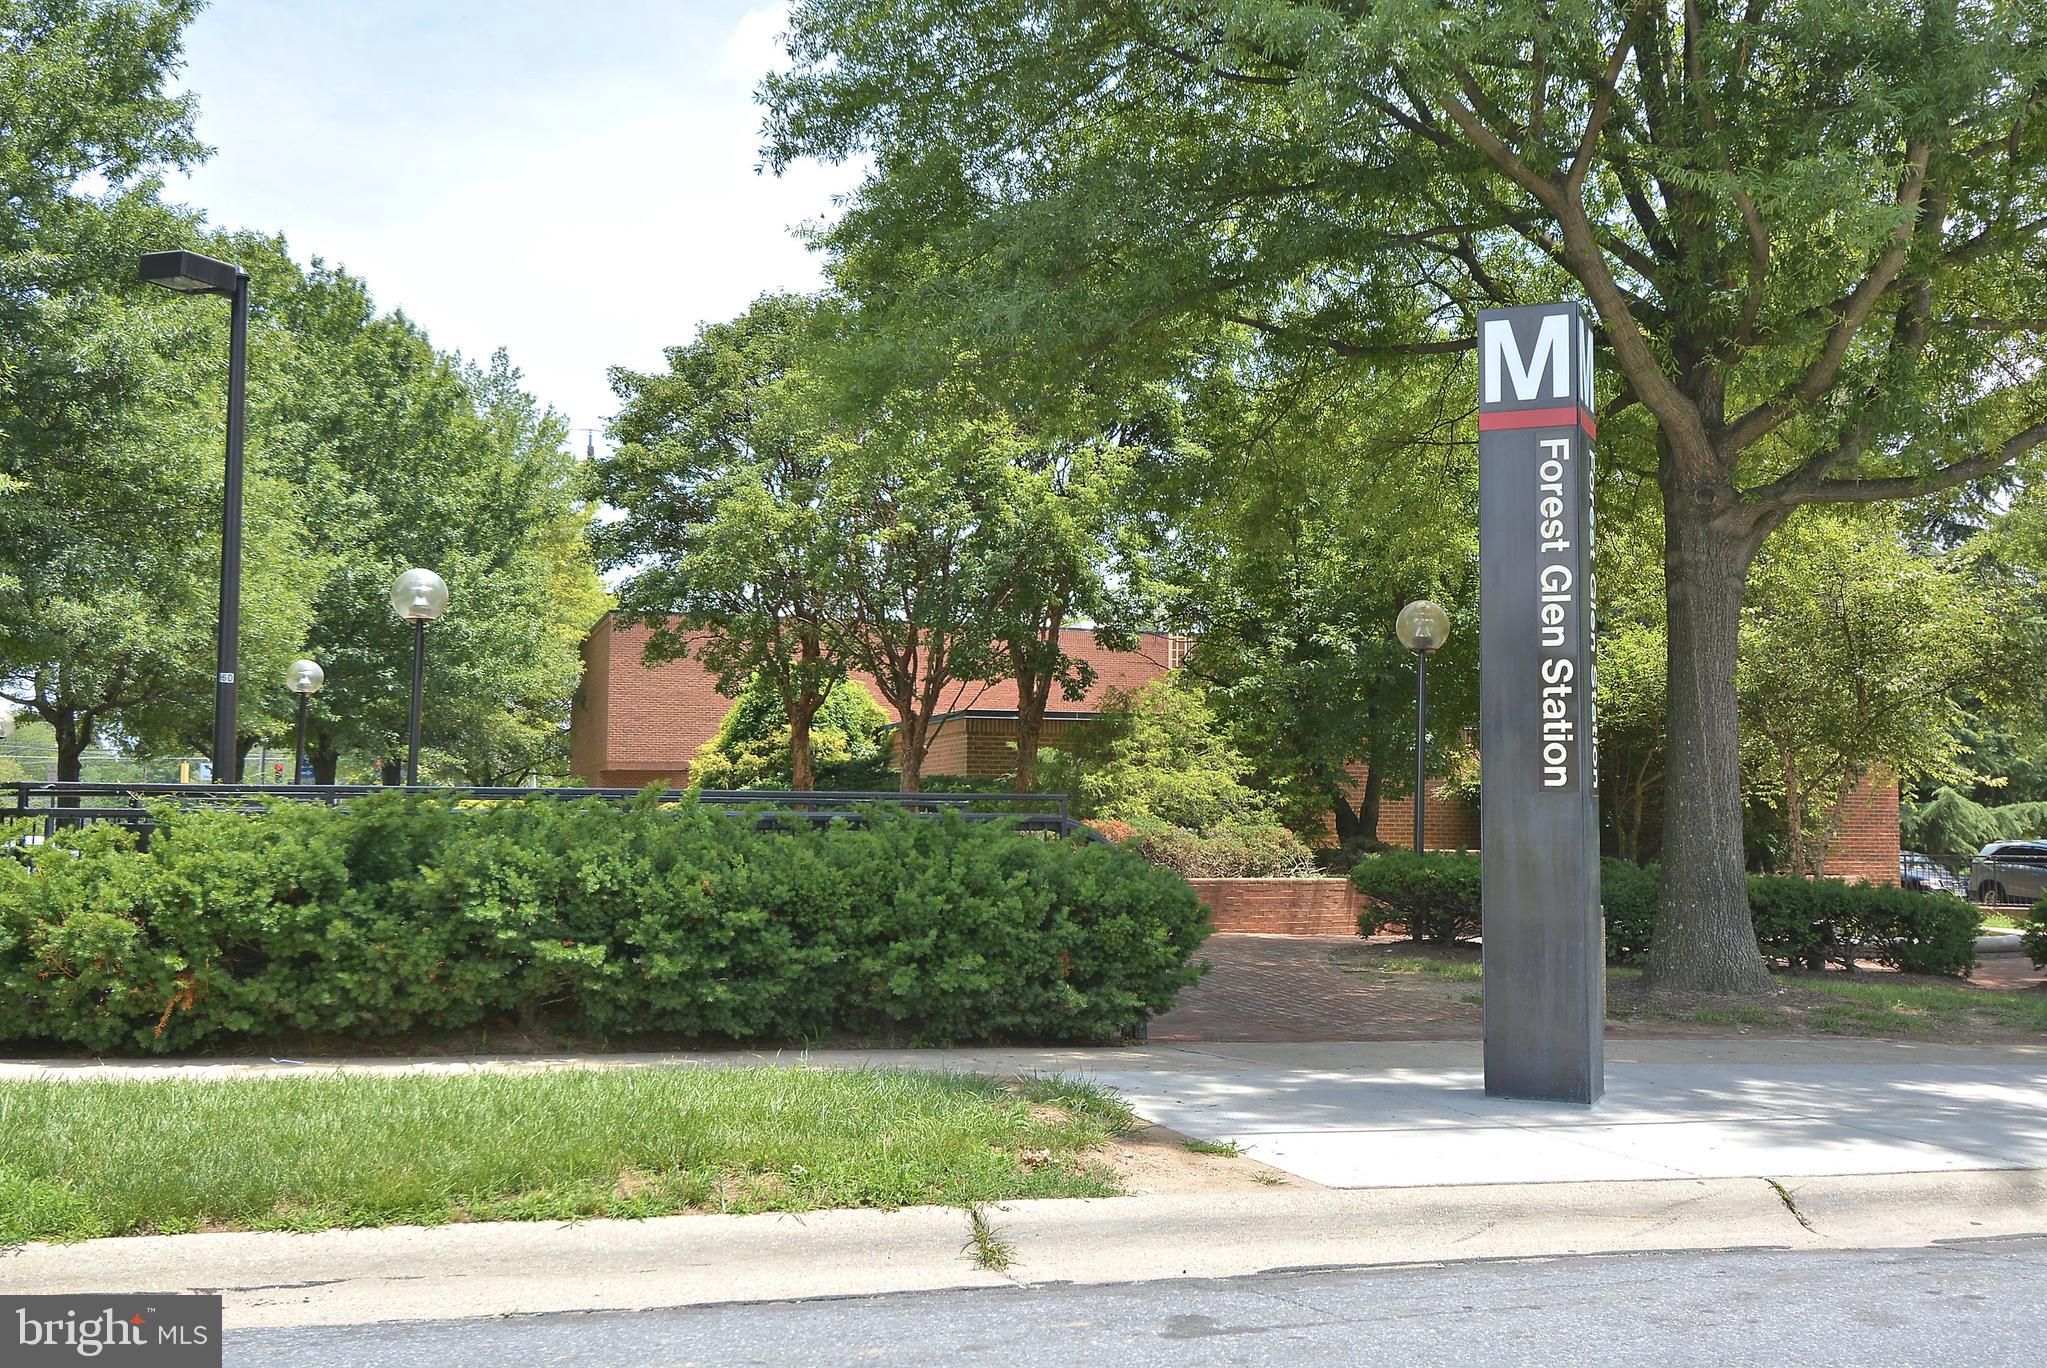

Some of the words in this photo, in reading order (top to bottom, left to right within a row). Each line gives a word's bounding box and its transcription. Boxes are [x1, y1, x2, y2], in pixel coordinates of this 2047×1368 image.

[1484, 313, 1570, 404] M
[1539, 438, 1571, 553] Forest
[1540, 564, 1573, 647] Glen
[1541, 658, 1575, 787] Station
